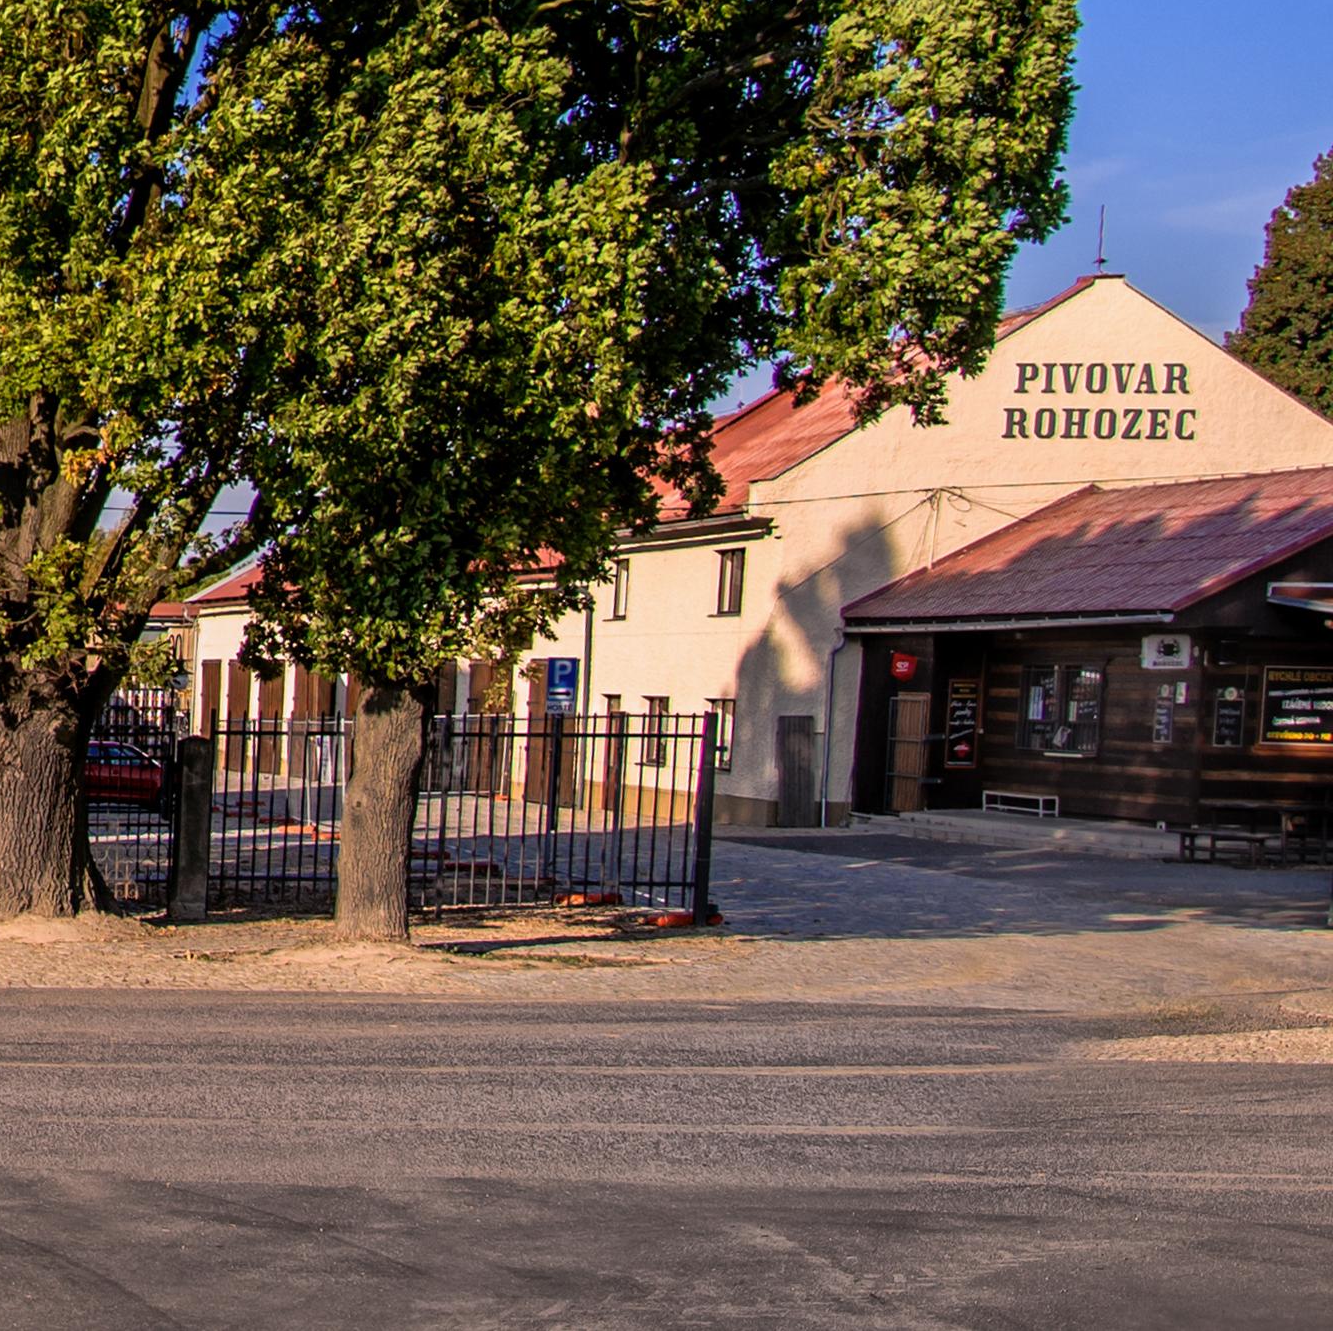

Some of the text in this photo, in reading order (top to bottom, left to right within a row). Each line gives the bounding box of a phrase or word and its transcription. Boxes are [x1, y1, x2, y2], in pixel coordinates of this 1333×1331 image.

[1013, 362, 1191, 394] PIVOVAR
[1001, 407, 1197, 441] ROHOZEC
[554, 660, 573, 684] P
